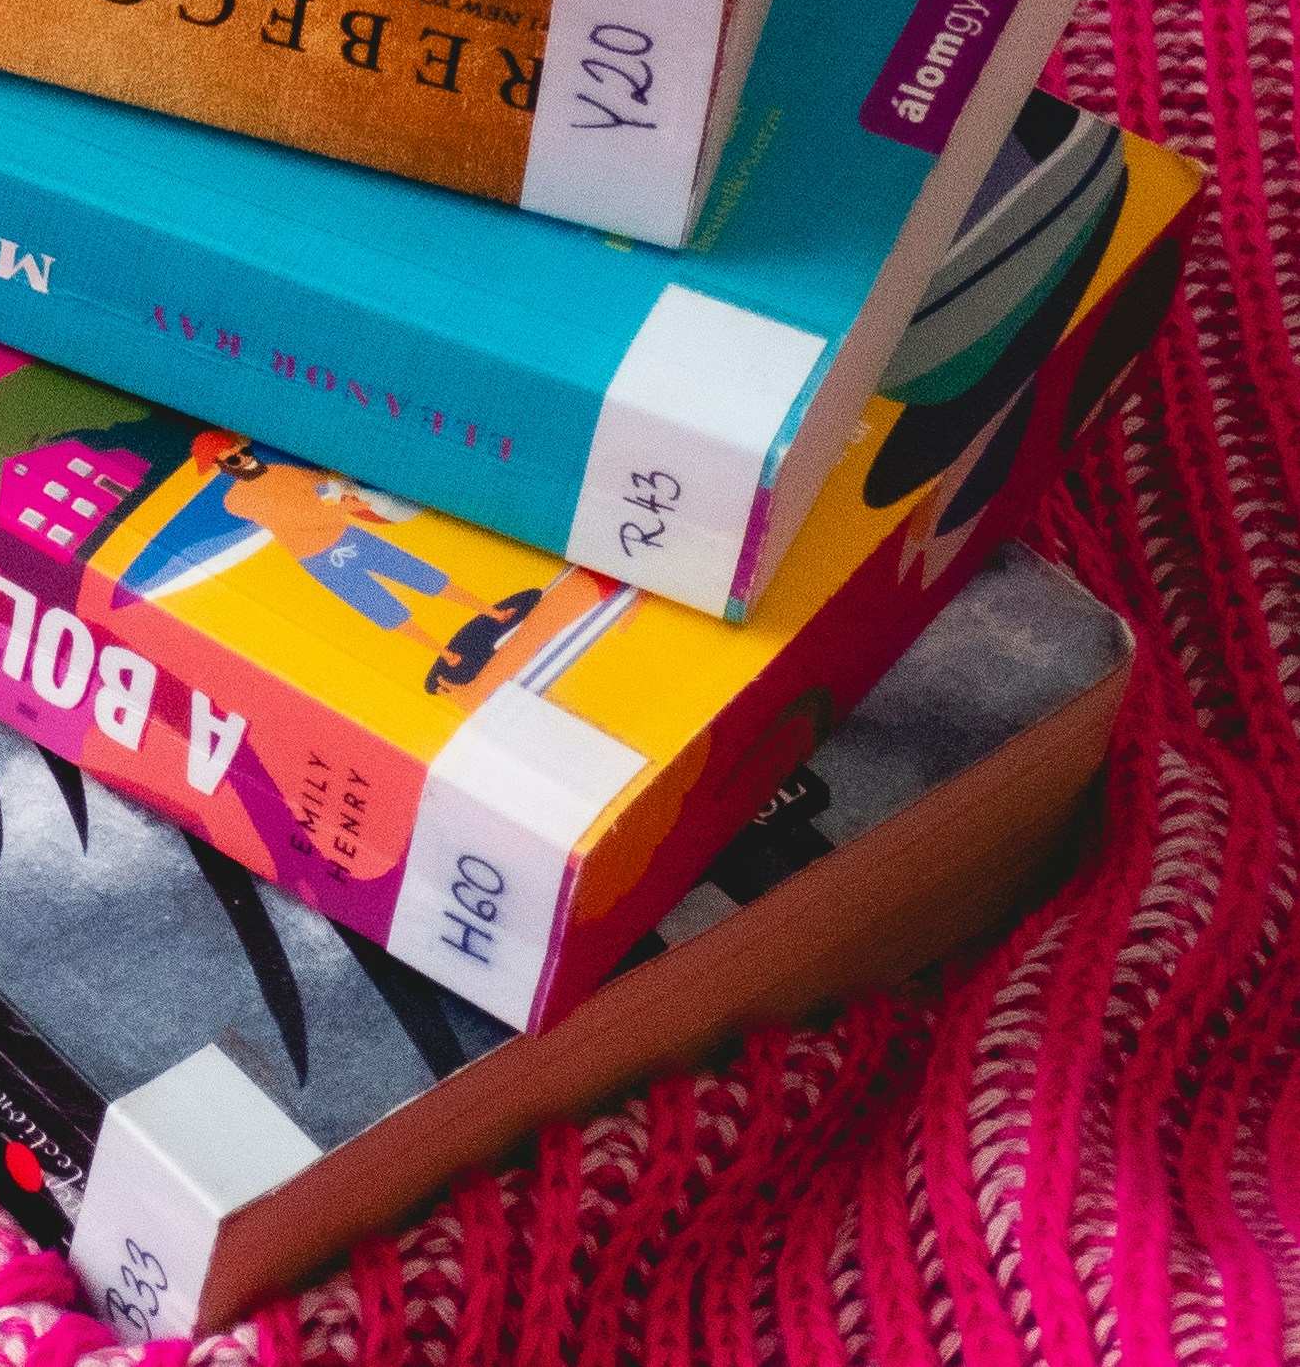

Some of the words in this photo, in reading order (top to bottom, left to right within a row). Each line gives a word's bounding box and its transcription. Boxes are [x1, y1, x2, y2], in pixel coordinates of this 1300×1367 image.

[457, 0, 523, 26] NEW
[570, 23, 656, 133] Y20
[152, 302, 243, 360] RAY
[269, 346, 516, 463] ELEANOR
[185, 690, 249, 797] A
[290, 750, 333, 856] EMILY
[327, 770, 373, 886] HENRY
[441, 853, 508, 965] H60
